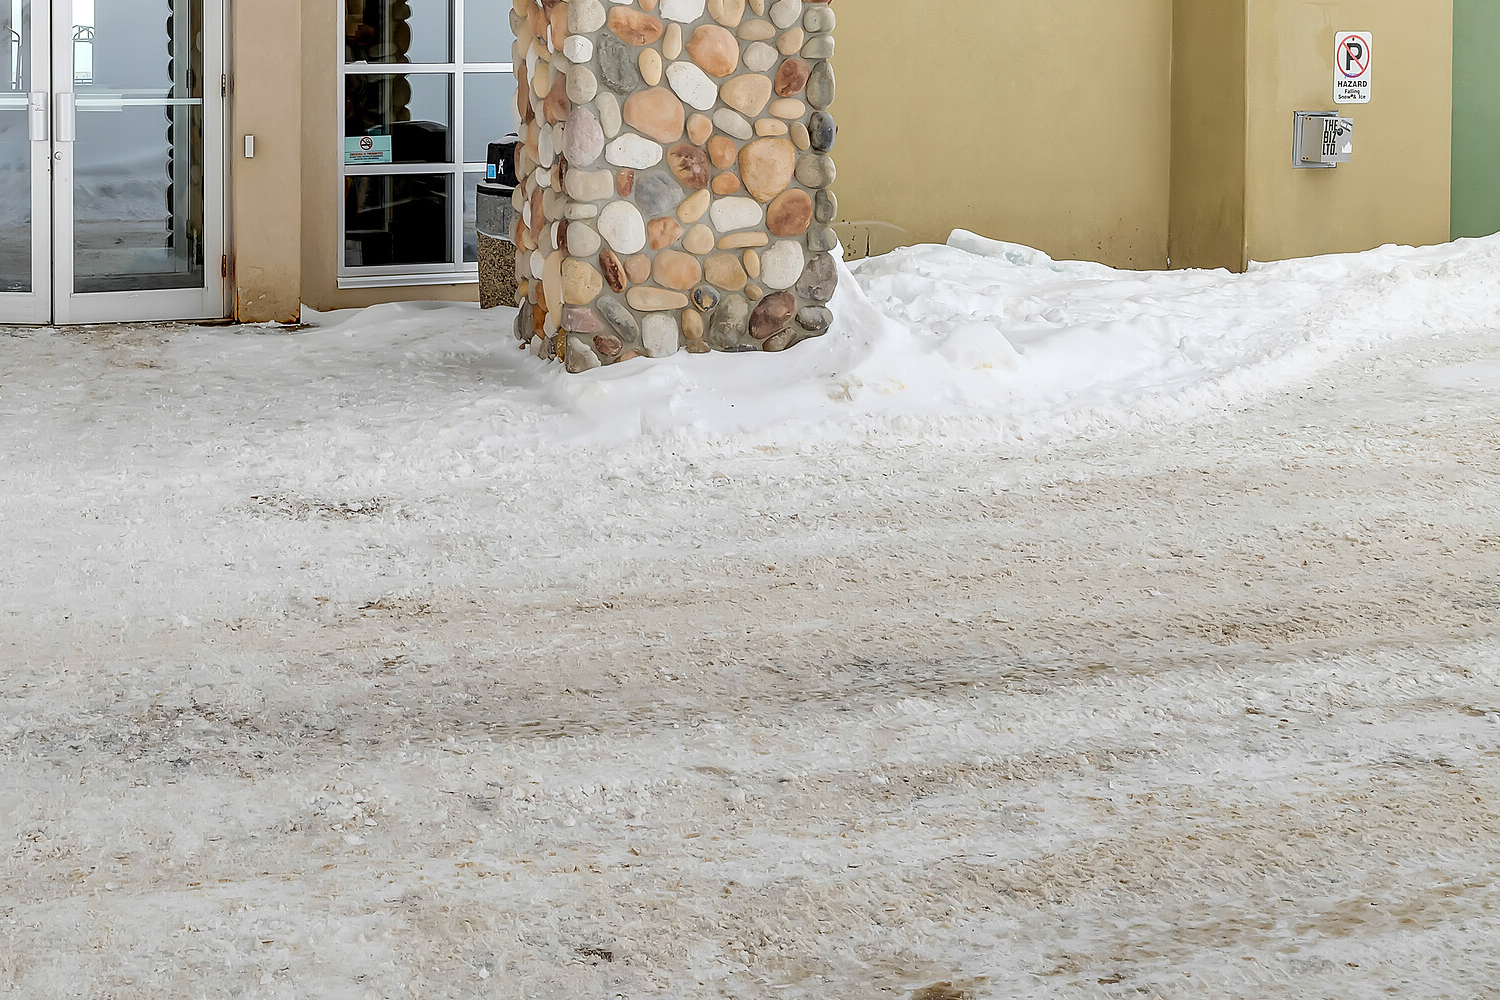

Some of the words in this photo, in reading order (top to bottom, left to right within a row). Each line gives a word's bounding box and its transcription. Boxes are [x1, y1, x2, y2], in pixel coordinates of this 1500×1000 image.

[1337, 80, 1368, 88] HAZARD
[1325, 119, 1338, 131] THE
[1322, 143, 1338, 155] LTD.
